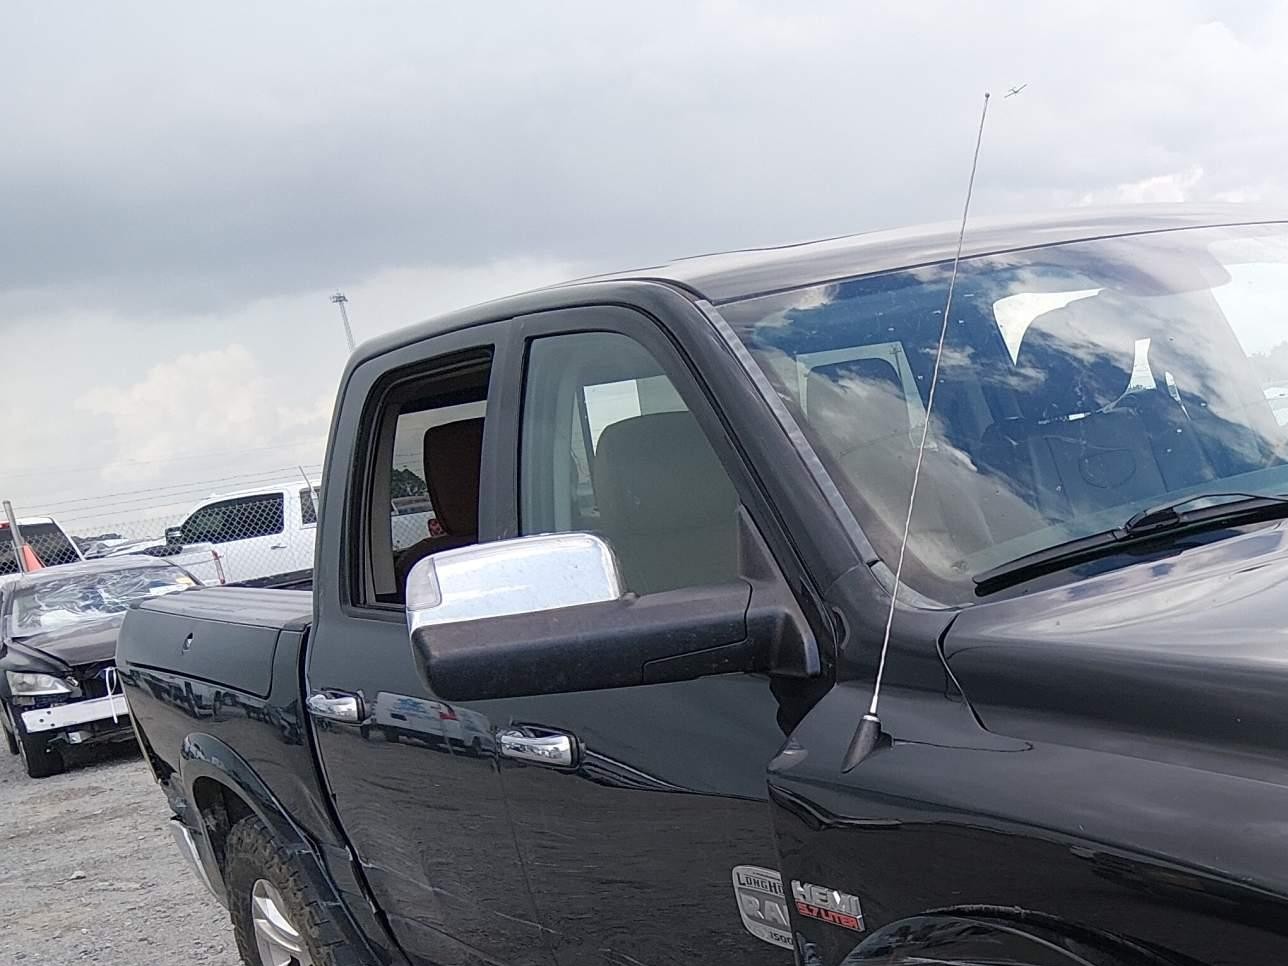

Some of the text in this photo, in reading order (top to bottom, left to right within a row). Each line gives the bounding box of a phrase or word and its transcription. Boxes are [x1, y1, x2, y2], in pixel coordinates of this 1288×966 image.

[736, 872, 785, 895] LONGHO
[791, 879, 862, 916] HEMI
[741, 894, 790, 927] RA
[821, 908, 859, 930] LITER
